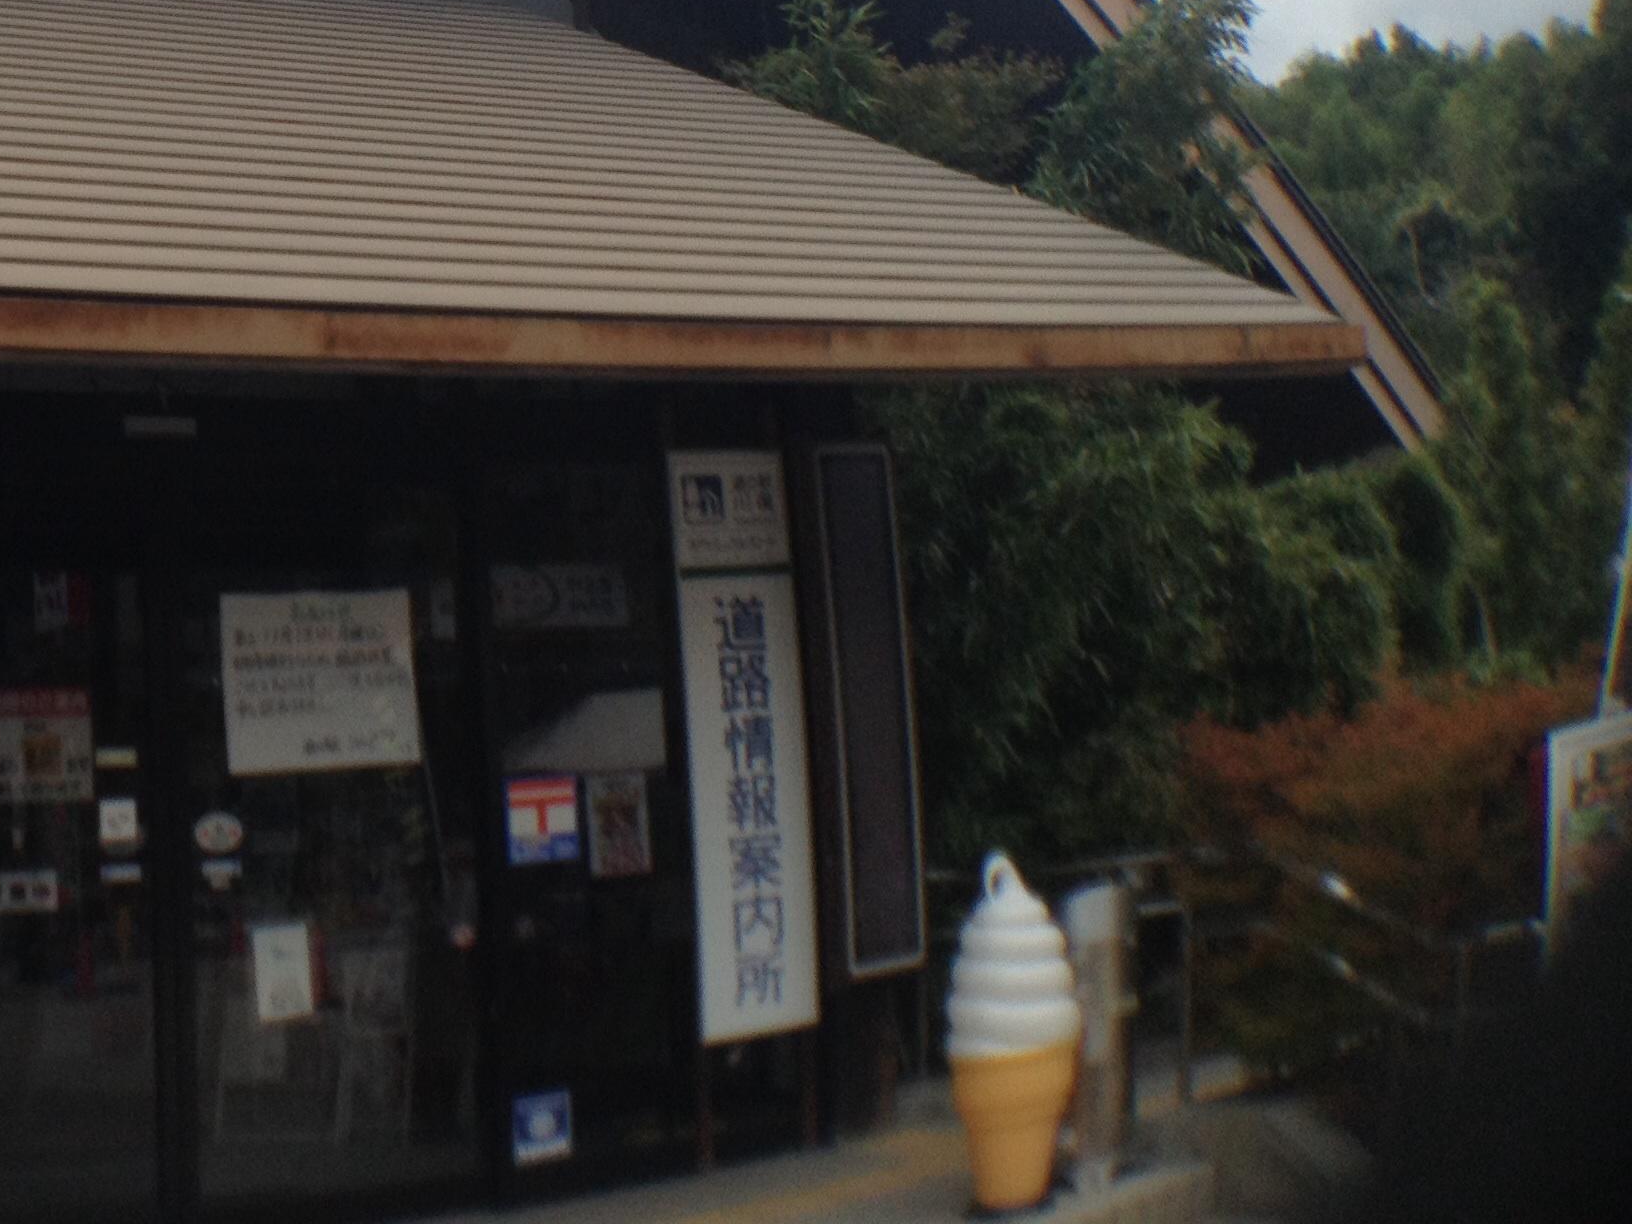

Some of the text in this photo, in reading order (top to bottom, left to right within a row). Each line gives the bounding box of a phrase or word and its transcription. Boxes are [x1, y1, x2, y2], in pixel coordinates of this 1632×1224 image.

[713, 595, 785, 1007] 道路情報案内所
